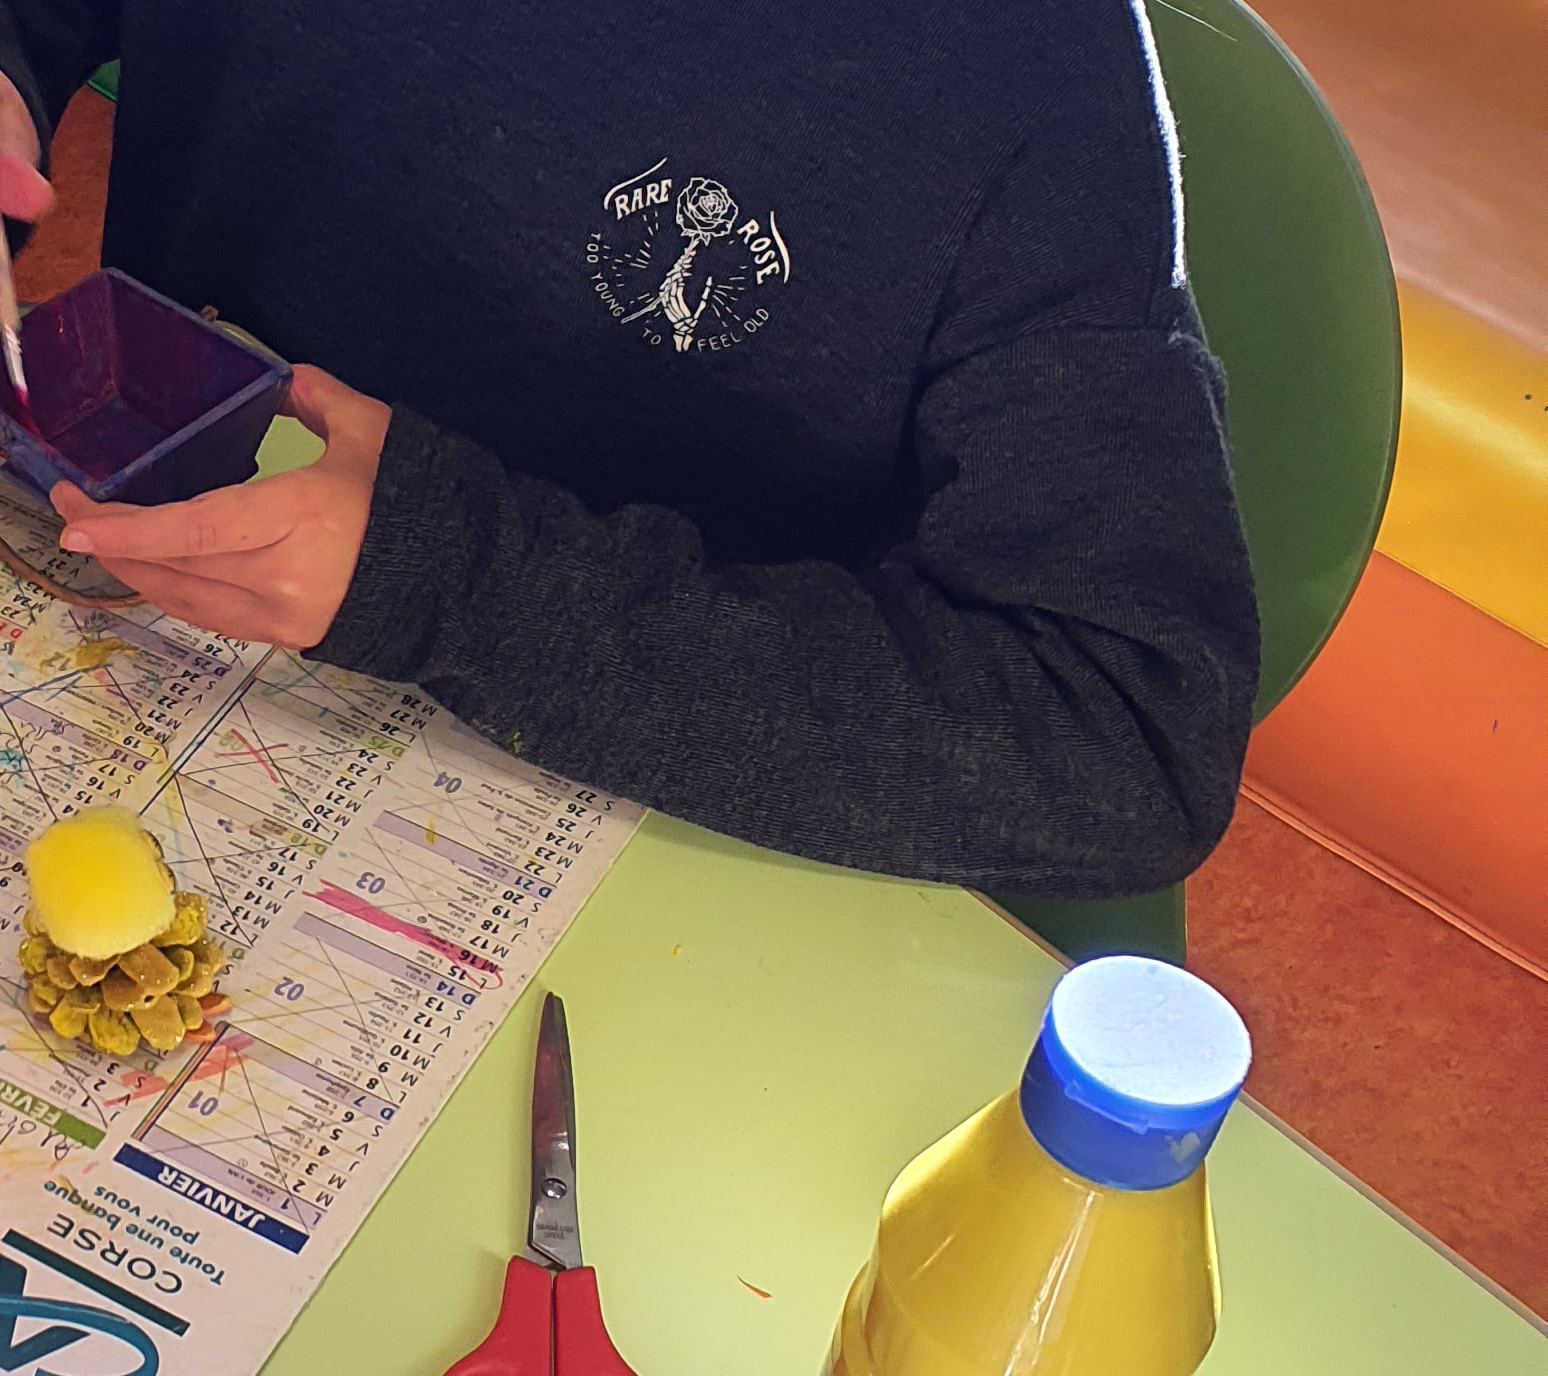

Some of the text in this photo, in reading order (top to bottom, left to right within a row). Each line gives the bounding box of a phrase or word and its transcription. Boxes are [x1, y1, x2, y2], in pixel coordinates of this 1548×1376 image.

[614, 179, 780, 284] RARE ROSE
[586, 233, 769, 352] TOO YOUNG TO FEEL OLD
[97, 763, 136, 784] S 17
[429, 769, 465, 796] 04
[86, 776, 121, 799] V 16
[575, 789, 615, 811] S 27
[565, 803, 602, 825] V 26
[555, 817, 594, 839] J 25
[545, 831, 583, 854] M 24
[534, 846, 573, 869] M 23
[352, 869, 389, 897] 03
[523, 859, 563, 883] L 22
[514, 875, 552, 898] D 21
[502, 890, 542, 912] S 20
[491, 905, 528, 928] V 19
[480, 919, 521, 942] J 18
[468, 935, 509, 958] M 17
[457, 948, 498, 973] M 16
[271, 974, 308, 1003] 02
[446, 963, 488, 989] L 15
[436, 980, 476, 1005] D 14
[424, 996, 465, 1021] S 13
[413, 1011, 451, 1038] V 12
[402, 1028, 443, 1053] J 11
[389, 1044, 430, 1070] M 10
[377, 1061, 419, 1086] M 9
[365, 1077, 407, 1103] L 8
[185, 1088, 222, 1119] 01
[353, 1095, 395, 1120] D 7
[341, 1110, 383, 1137] S 6
[329, 1128, 369, 1155] V 5
[317, 1145, 360, 1172] J 4
[304, 1162, 347, 1189] M 3
[157, 1160, 265, 1228] JANVIER
[292, 1178, 334, 1207] M 2
[94, 1186, 200, 1245] pour vous
[280, 1197, 322, 1225] L 1
[36, 1170, 225, 1285] Toute une banque
[46, 1213, 182, 1293] CORSE
